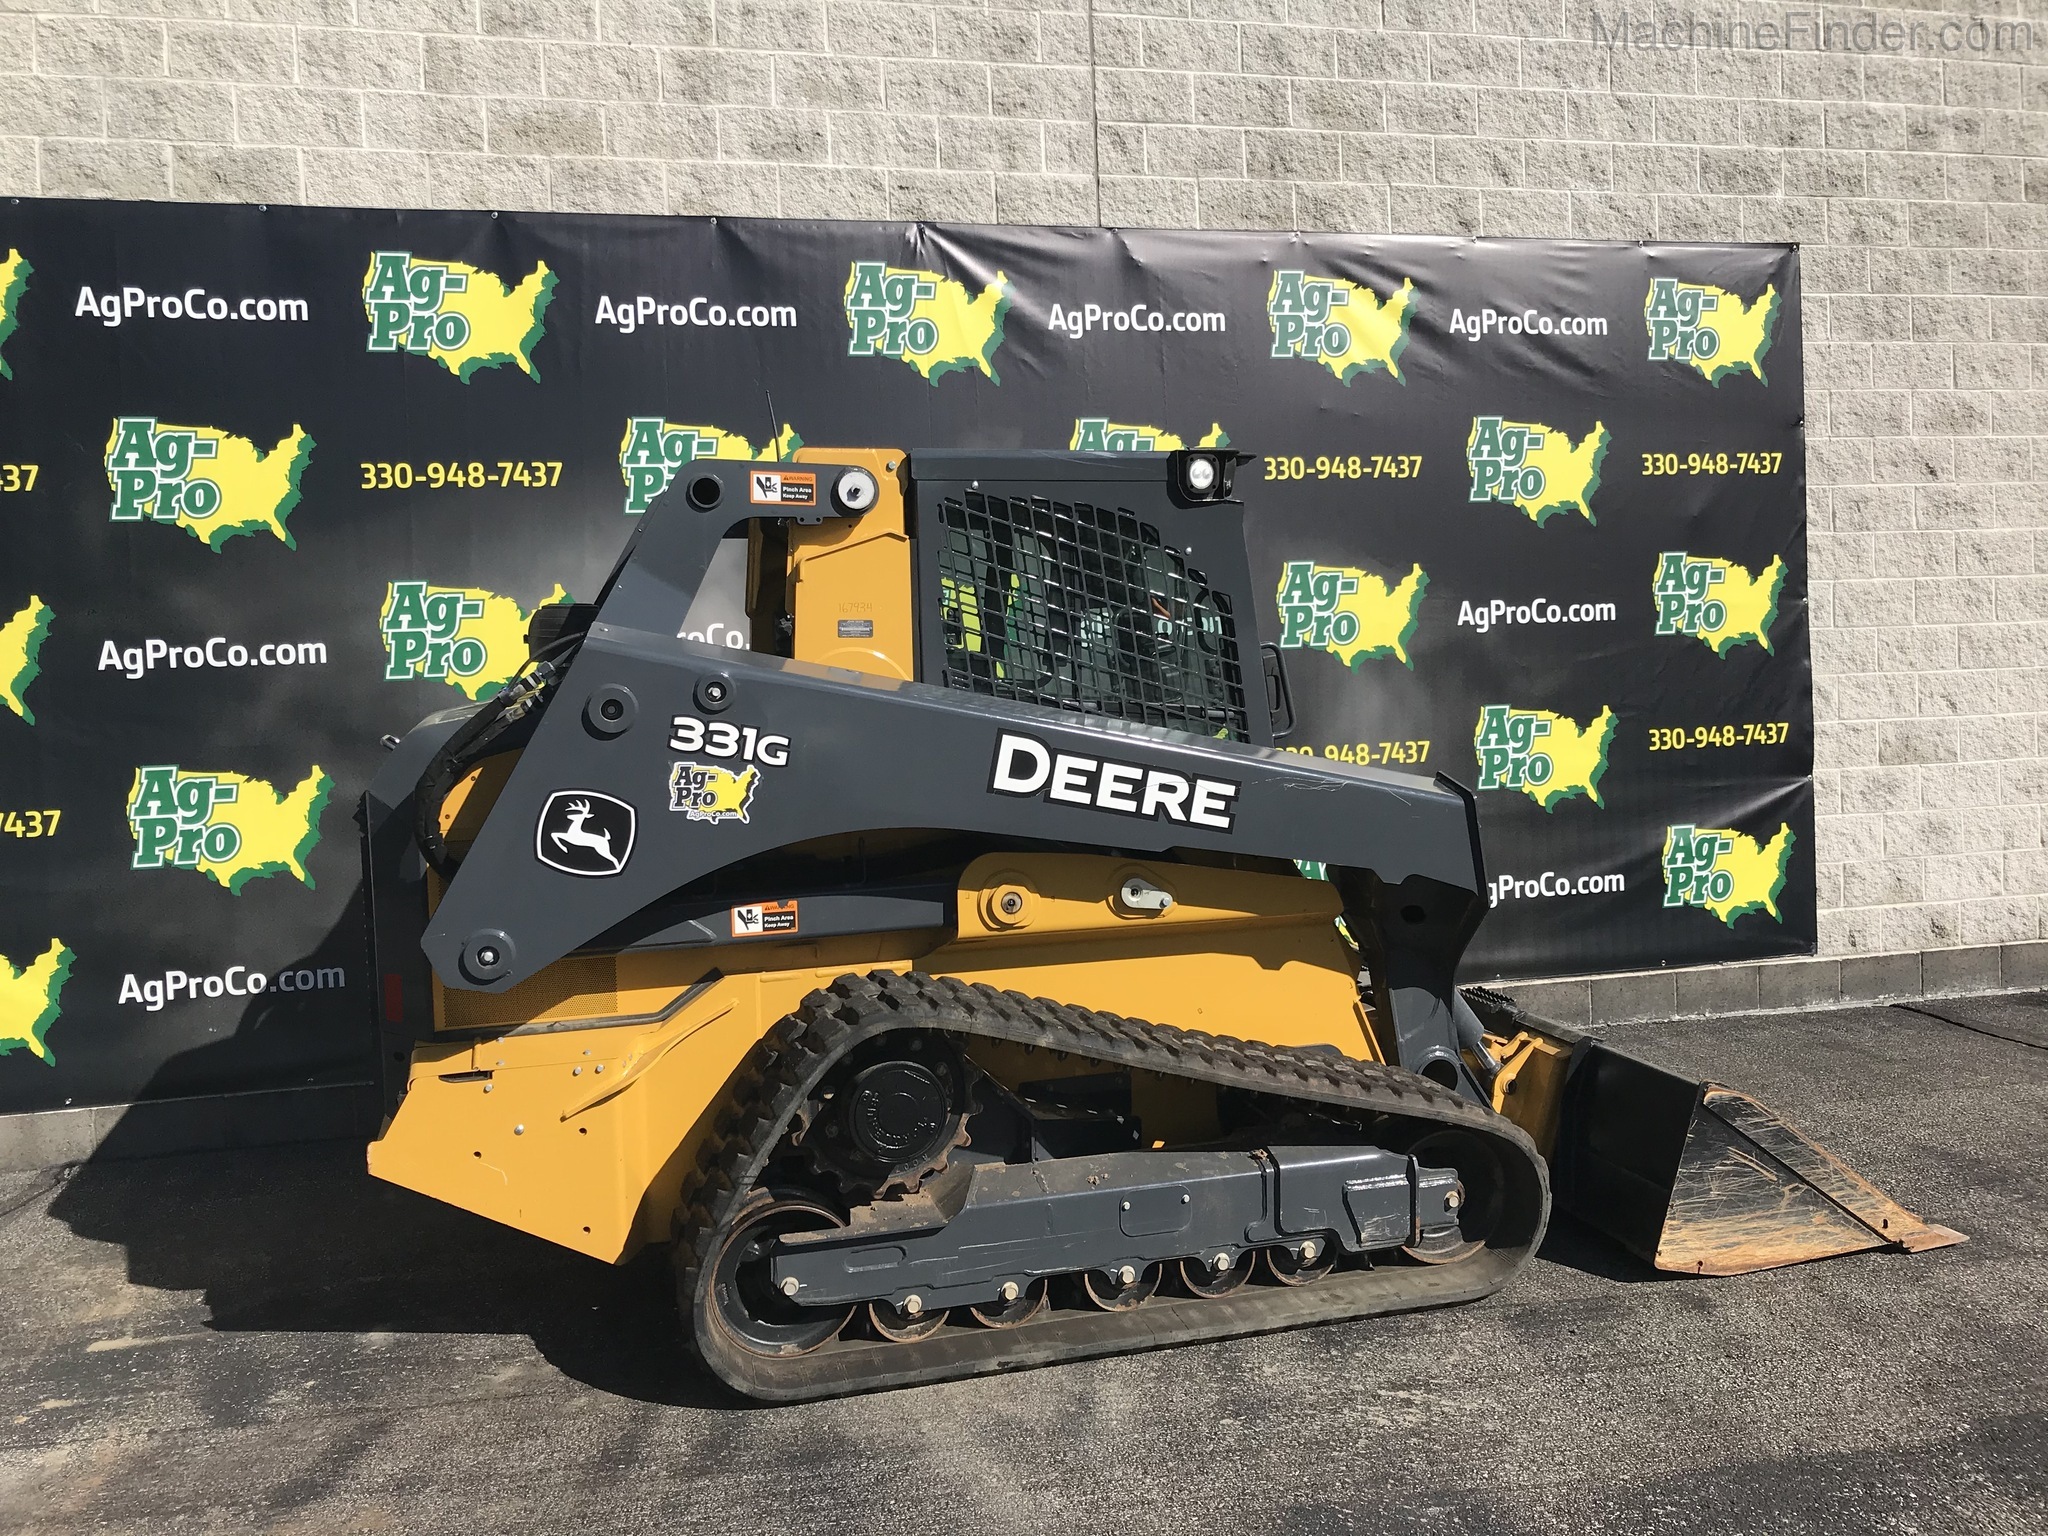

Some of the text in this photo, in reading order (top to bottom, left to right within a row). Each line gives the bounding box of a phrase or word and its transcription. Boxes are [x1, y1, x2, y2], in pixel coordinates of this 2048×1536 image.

[368, 251, 467, 312] Ag-
[849, 262, 935, 313] Ag-
[1271, 270, 1348, 318] Ag-
[1648, 278, 1717, 325] Ag-
[75, 287, 309, 327] AgProCo.com
[367, 301, 469, 351] Pro
[595, 295, 797, 334] AgProCo.com
[1048, 303, 1226, 340] AgProCo.com
[1449, 308, 1608, 342] AgProCo.com
[849, 307, 938, 356] Pro
[1271, 312, 1351, 358] Pro
[1648, 320, 1719, 361] Pro
[110, 417, 218, 479] Ag-
[623, 418, 717, 467] Ag-
[1469, 416, 1544, 464] Ag-
[0, 464, 39, 491] 37
[361, 461, 563, 489] 330-948-7437
[1264, 456, 1423, 480] 330-948-7437
[1469, 459, 1545, 502] Pro
[1642, 453, 1782, 476] 330-948-7437
[110, 467, 220, 519] Pro
[1281, 562, 1358, 609] Ag-
[1656, 551, 1724, 598] Ag-
[387, 581, 484, 637] Ag-
[1281, 603, 1359, 648] Pro
[1457, 598, 1616, 633] AgProCo.com
[1656, 594, 1727, 636] Pro
[98, 637, 327, 679] AgProCo.com
[385, 632, 486, 680] Pro
[670, 716, 789, 766] 331G
[1479, 705, 1551, 753] Ag-
[1649, 723, 1789, 750] 330-948-7437
[674, 764, 717, 791] Ag-
[993, 734, 1236, 829] DEERE
[1478, 746, 1553, 790] Pro
[130, 766, 239, 825] Ag-
[673, 786, 717, 808] Pro
[689, 810, 738, 818] AgProCo.com
[0, 810, 61, 838] 437
[132, 816, 241, 869] Pro
[1665, 825, 1731, 870] Ag-
[1487, 871, 1625, 908] gProCo.com
[1664, 864, 1734, 907] Pro
[118, 965, 346, 1012] AgProCo.com
